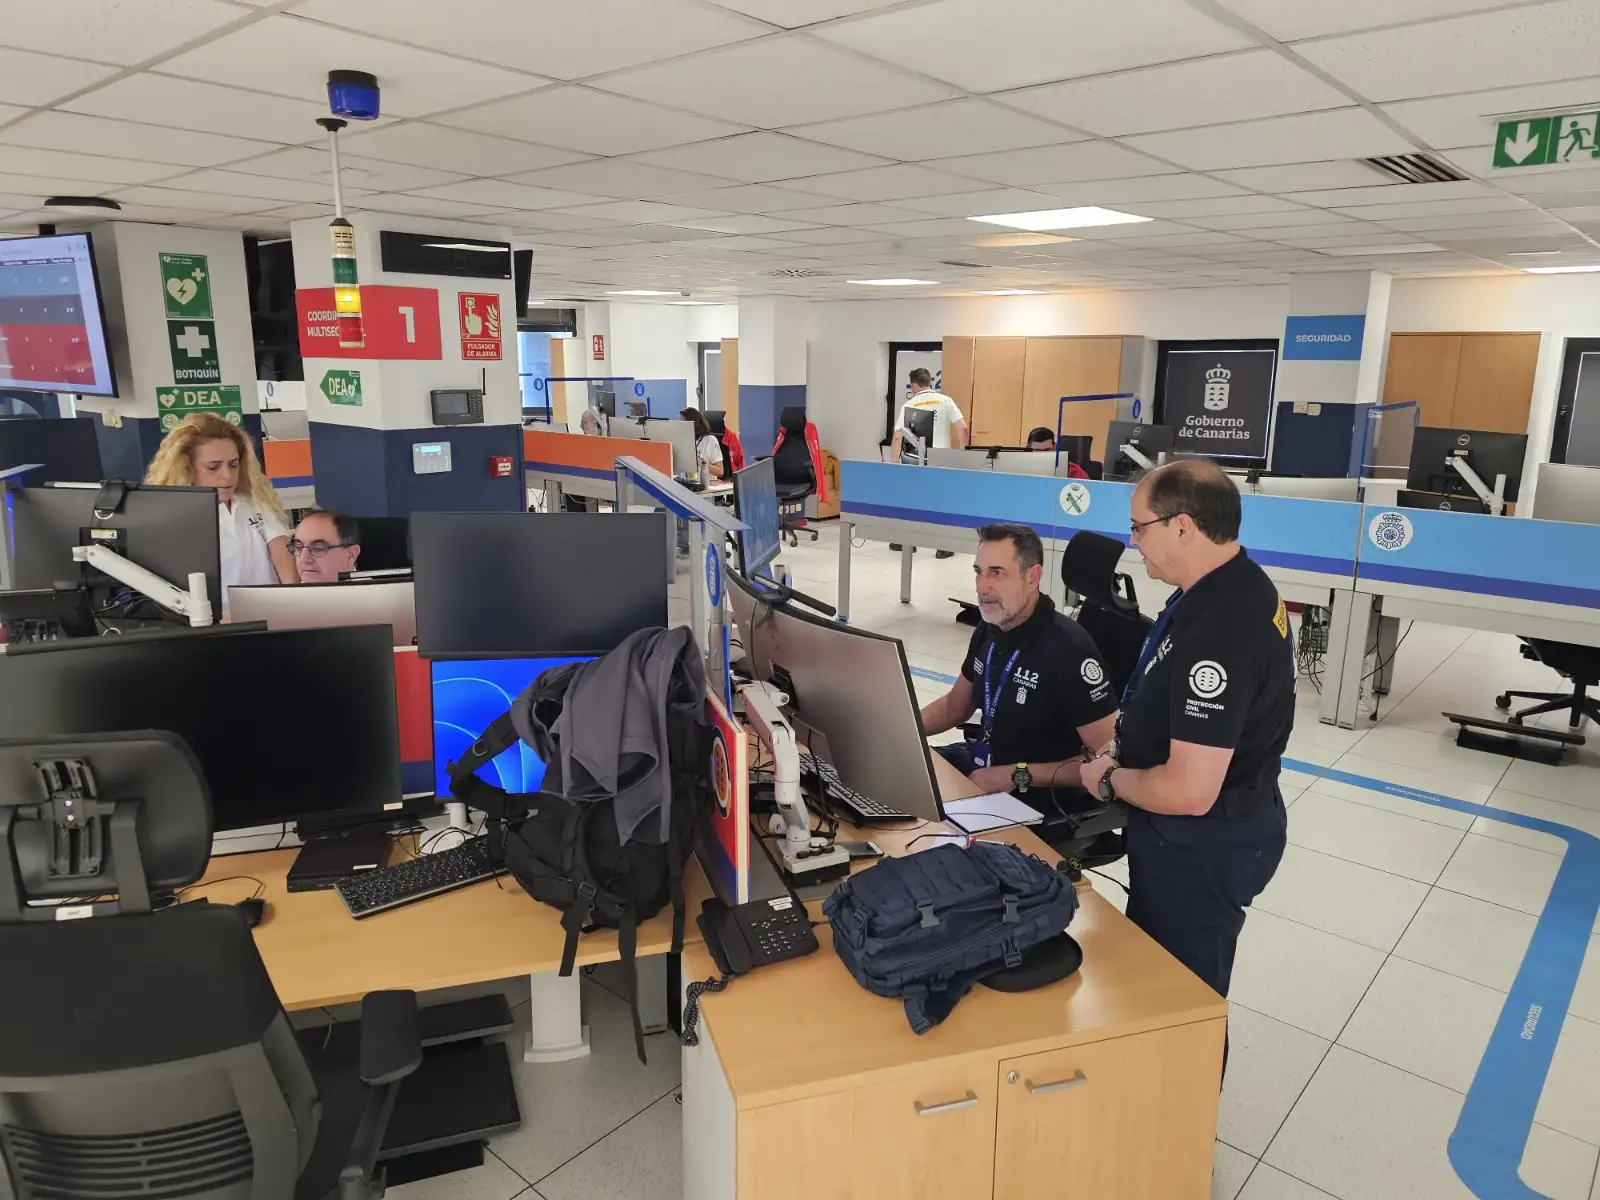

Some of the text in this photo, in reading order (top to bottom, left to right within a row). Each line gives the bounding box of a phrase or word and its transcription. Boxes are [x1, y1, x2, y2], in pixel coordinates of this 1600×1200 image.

[398, 306, 416, 343] 1
[306, 326, 340, 337] MULTISEC
[1295, 334, 1352, 342] SEGURIDAD
[175, 367, 219, 379] BOTIQUÍN
[328, 377, 348, 396] DEA
[183, 390, 222, 406] DEA
[1185, 415, 1245, 427] Gobierno
[1178, 427, 1251, 439] de Canarias
[1014, 667, 1039, 684] 112
[1186, 698, 1225, 711] PROTECCIÓN
[1184, 710, 1209, 719] CANARIAS
